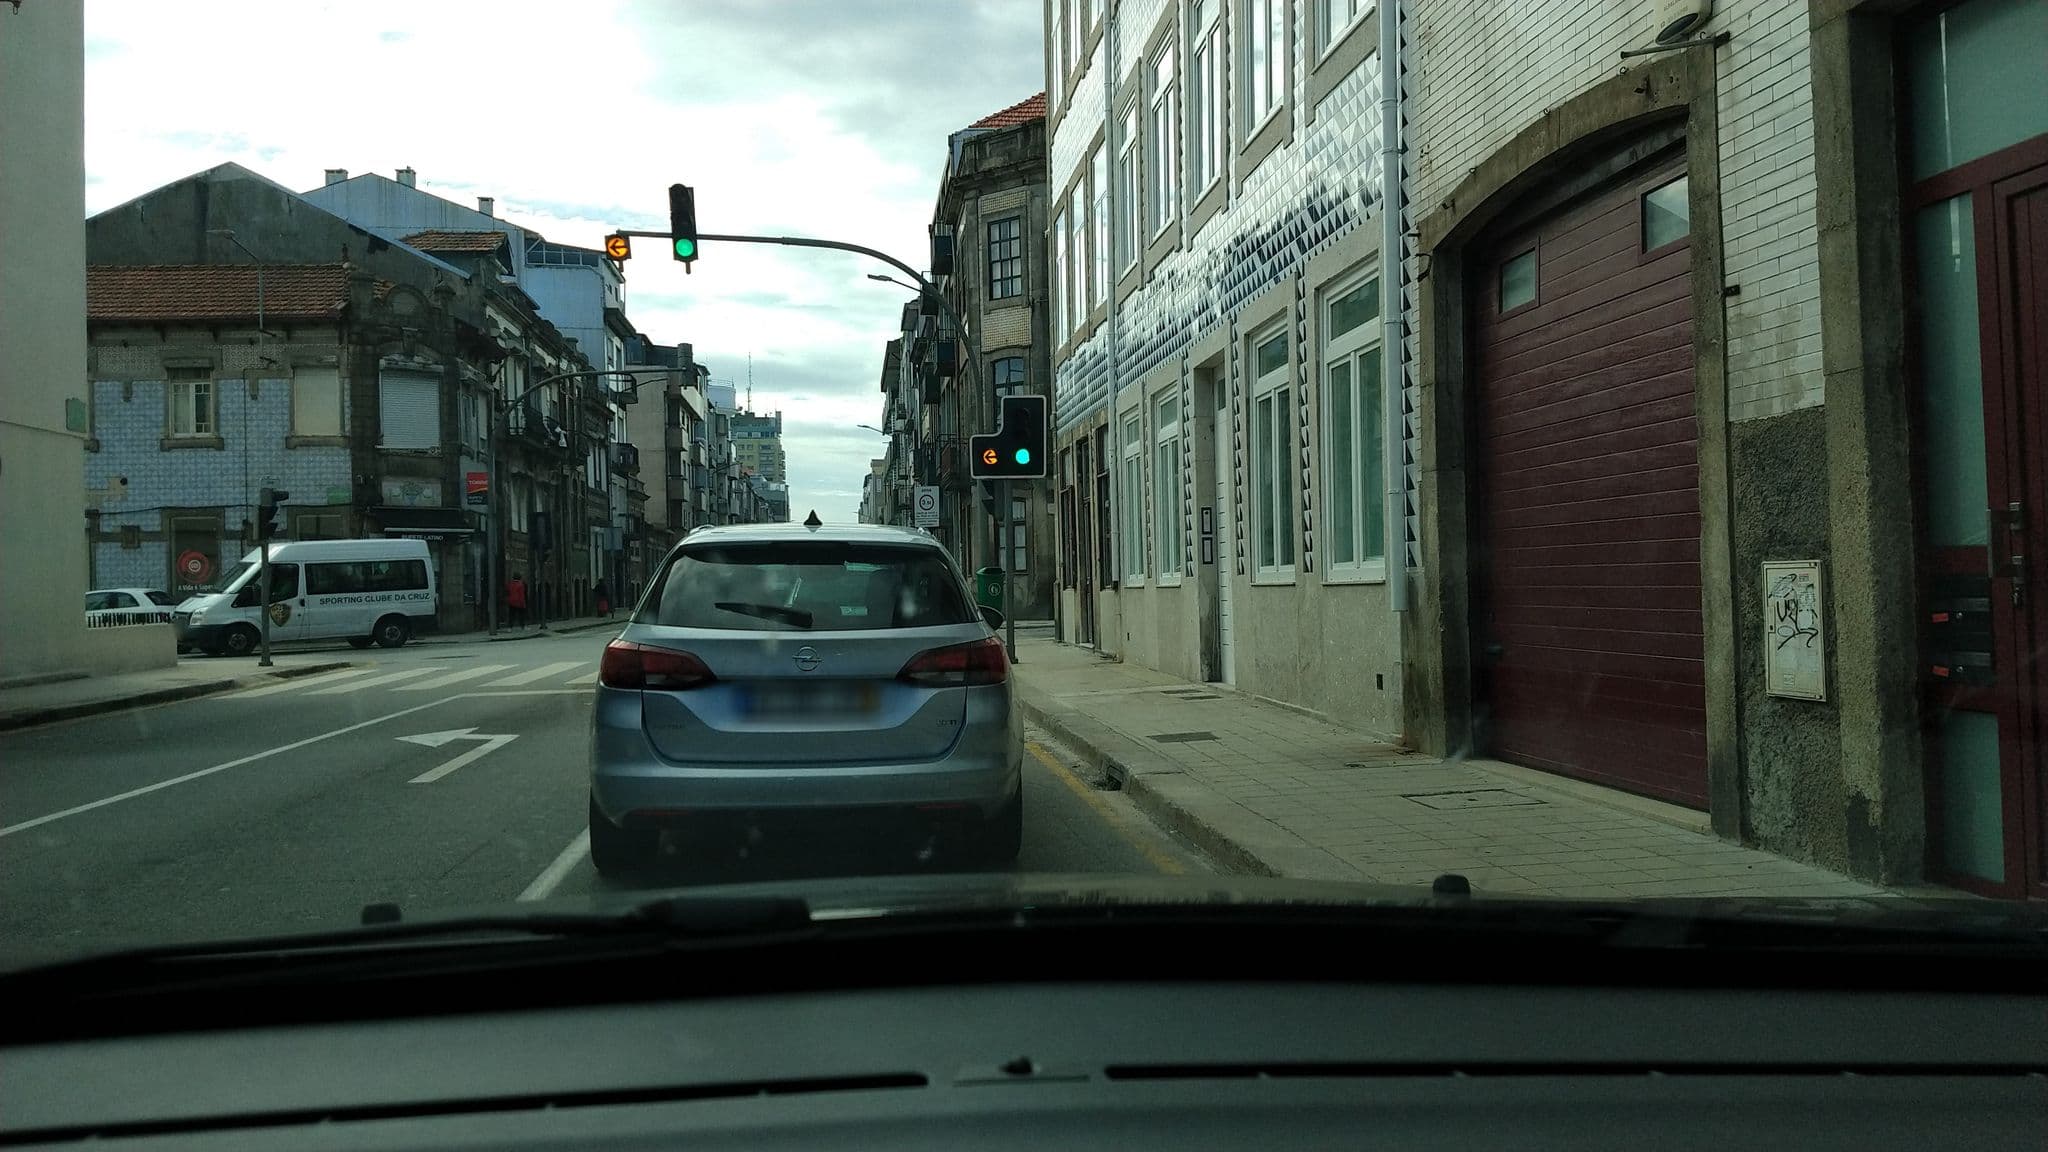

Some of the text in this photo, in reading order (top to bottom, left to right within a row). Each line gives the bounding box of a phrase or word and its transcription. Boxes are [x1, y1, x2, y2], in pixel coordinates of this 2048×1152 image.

[319, 592, 431, 605] SPORTING CLUBE DA CRUZ
